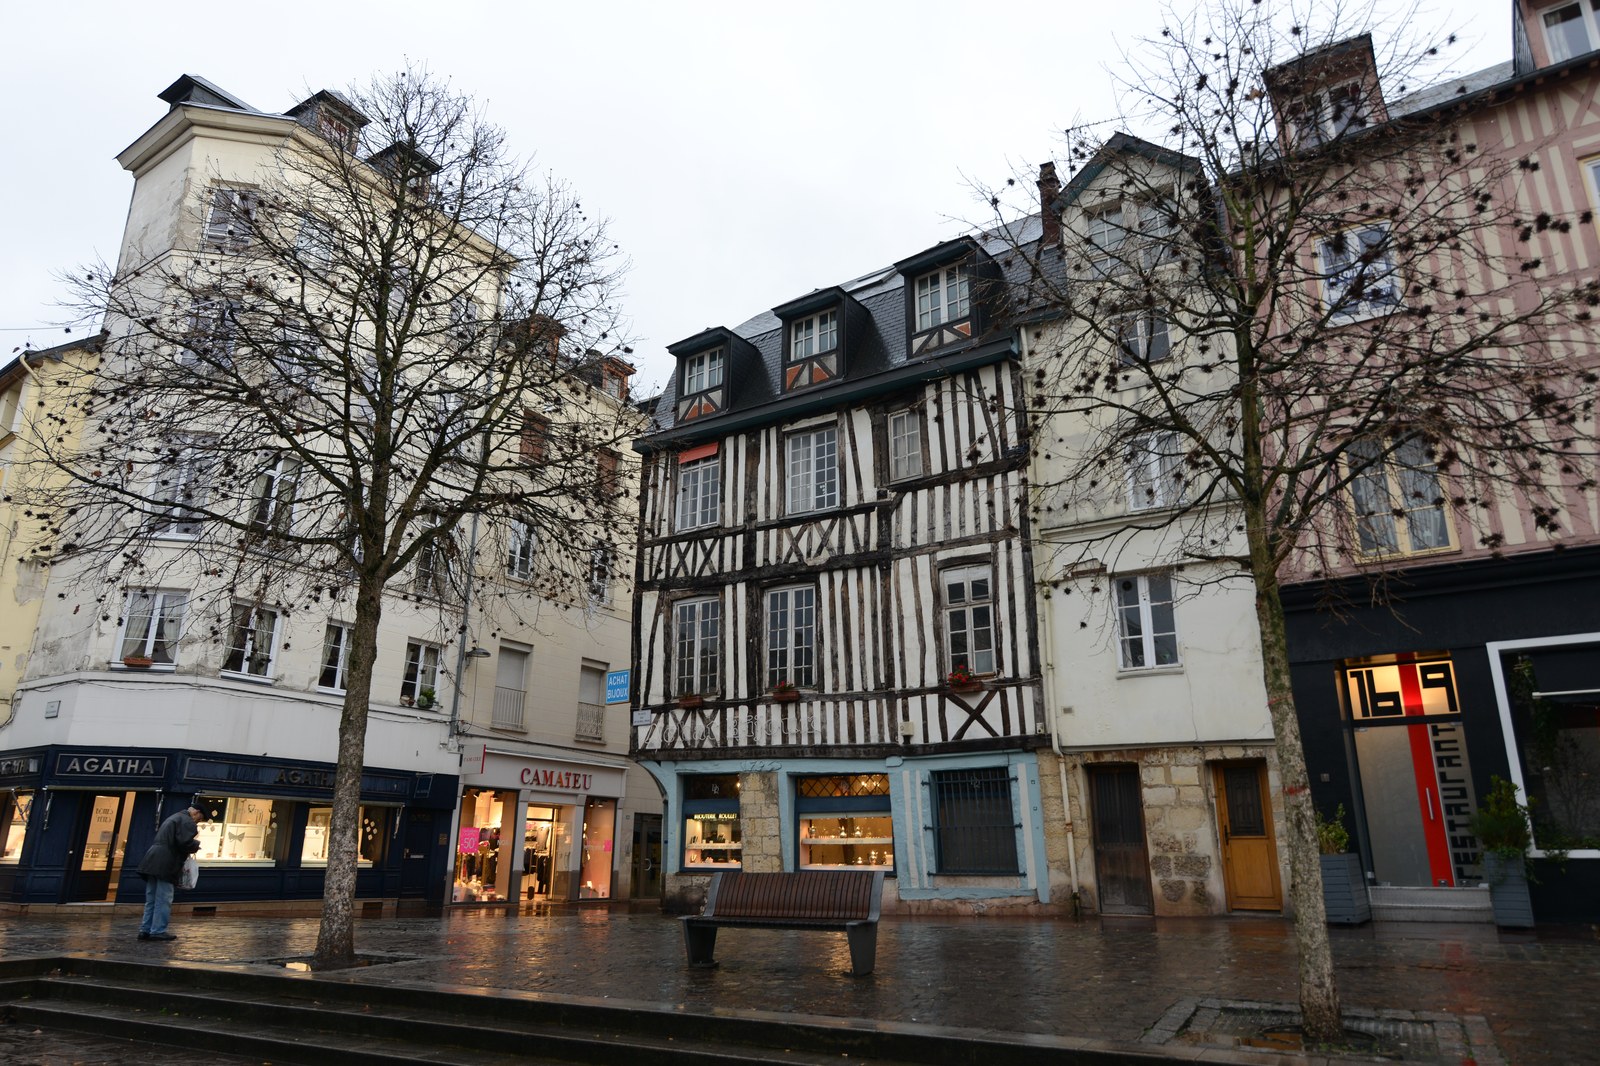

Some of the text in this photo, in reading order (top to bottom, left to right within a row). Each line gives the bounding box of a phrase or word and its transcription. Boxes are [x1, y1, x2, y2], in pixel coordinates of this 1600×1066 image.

[608, 674, 628, 686] ACHAT
[607, 688, 629, 699] BIJOUX
[66, 757, 155, 775] AGATHA
[275, 769, 335, 788] AGATH
